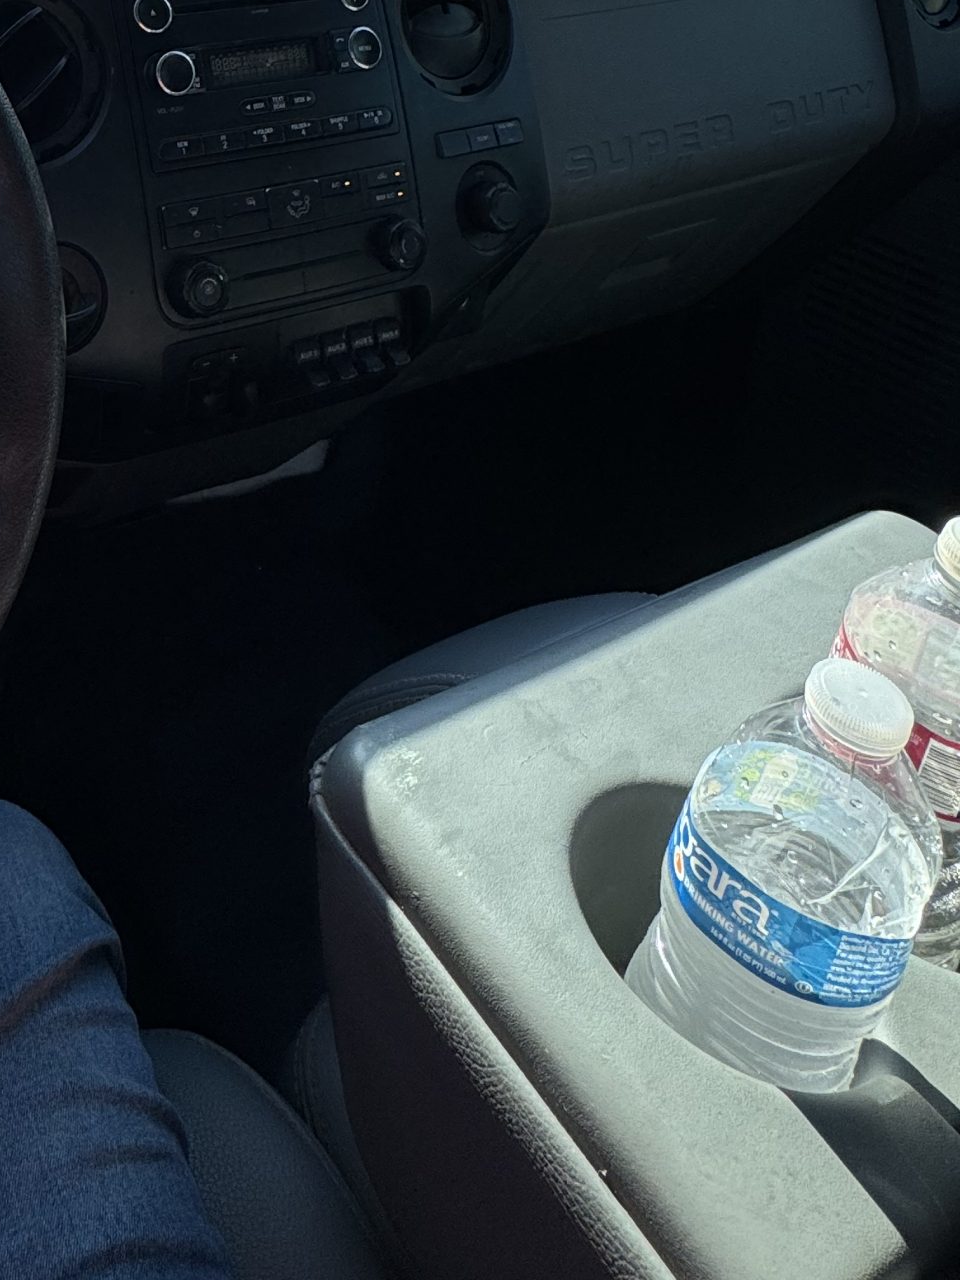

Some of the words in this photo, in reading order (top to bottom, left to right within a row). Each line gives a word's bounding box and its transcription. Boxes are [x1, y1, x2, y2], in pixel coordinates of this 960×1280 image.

[562, 113, 736, 182] SUPER
[766, 79, 876, 135] DUTY
[683, 875, 735, 933] DRINKING
[737, 929, 785, 967] WATER
